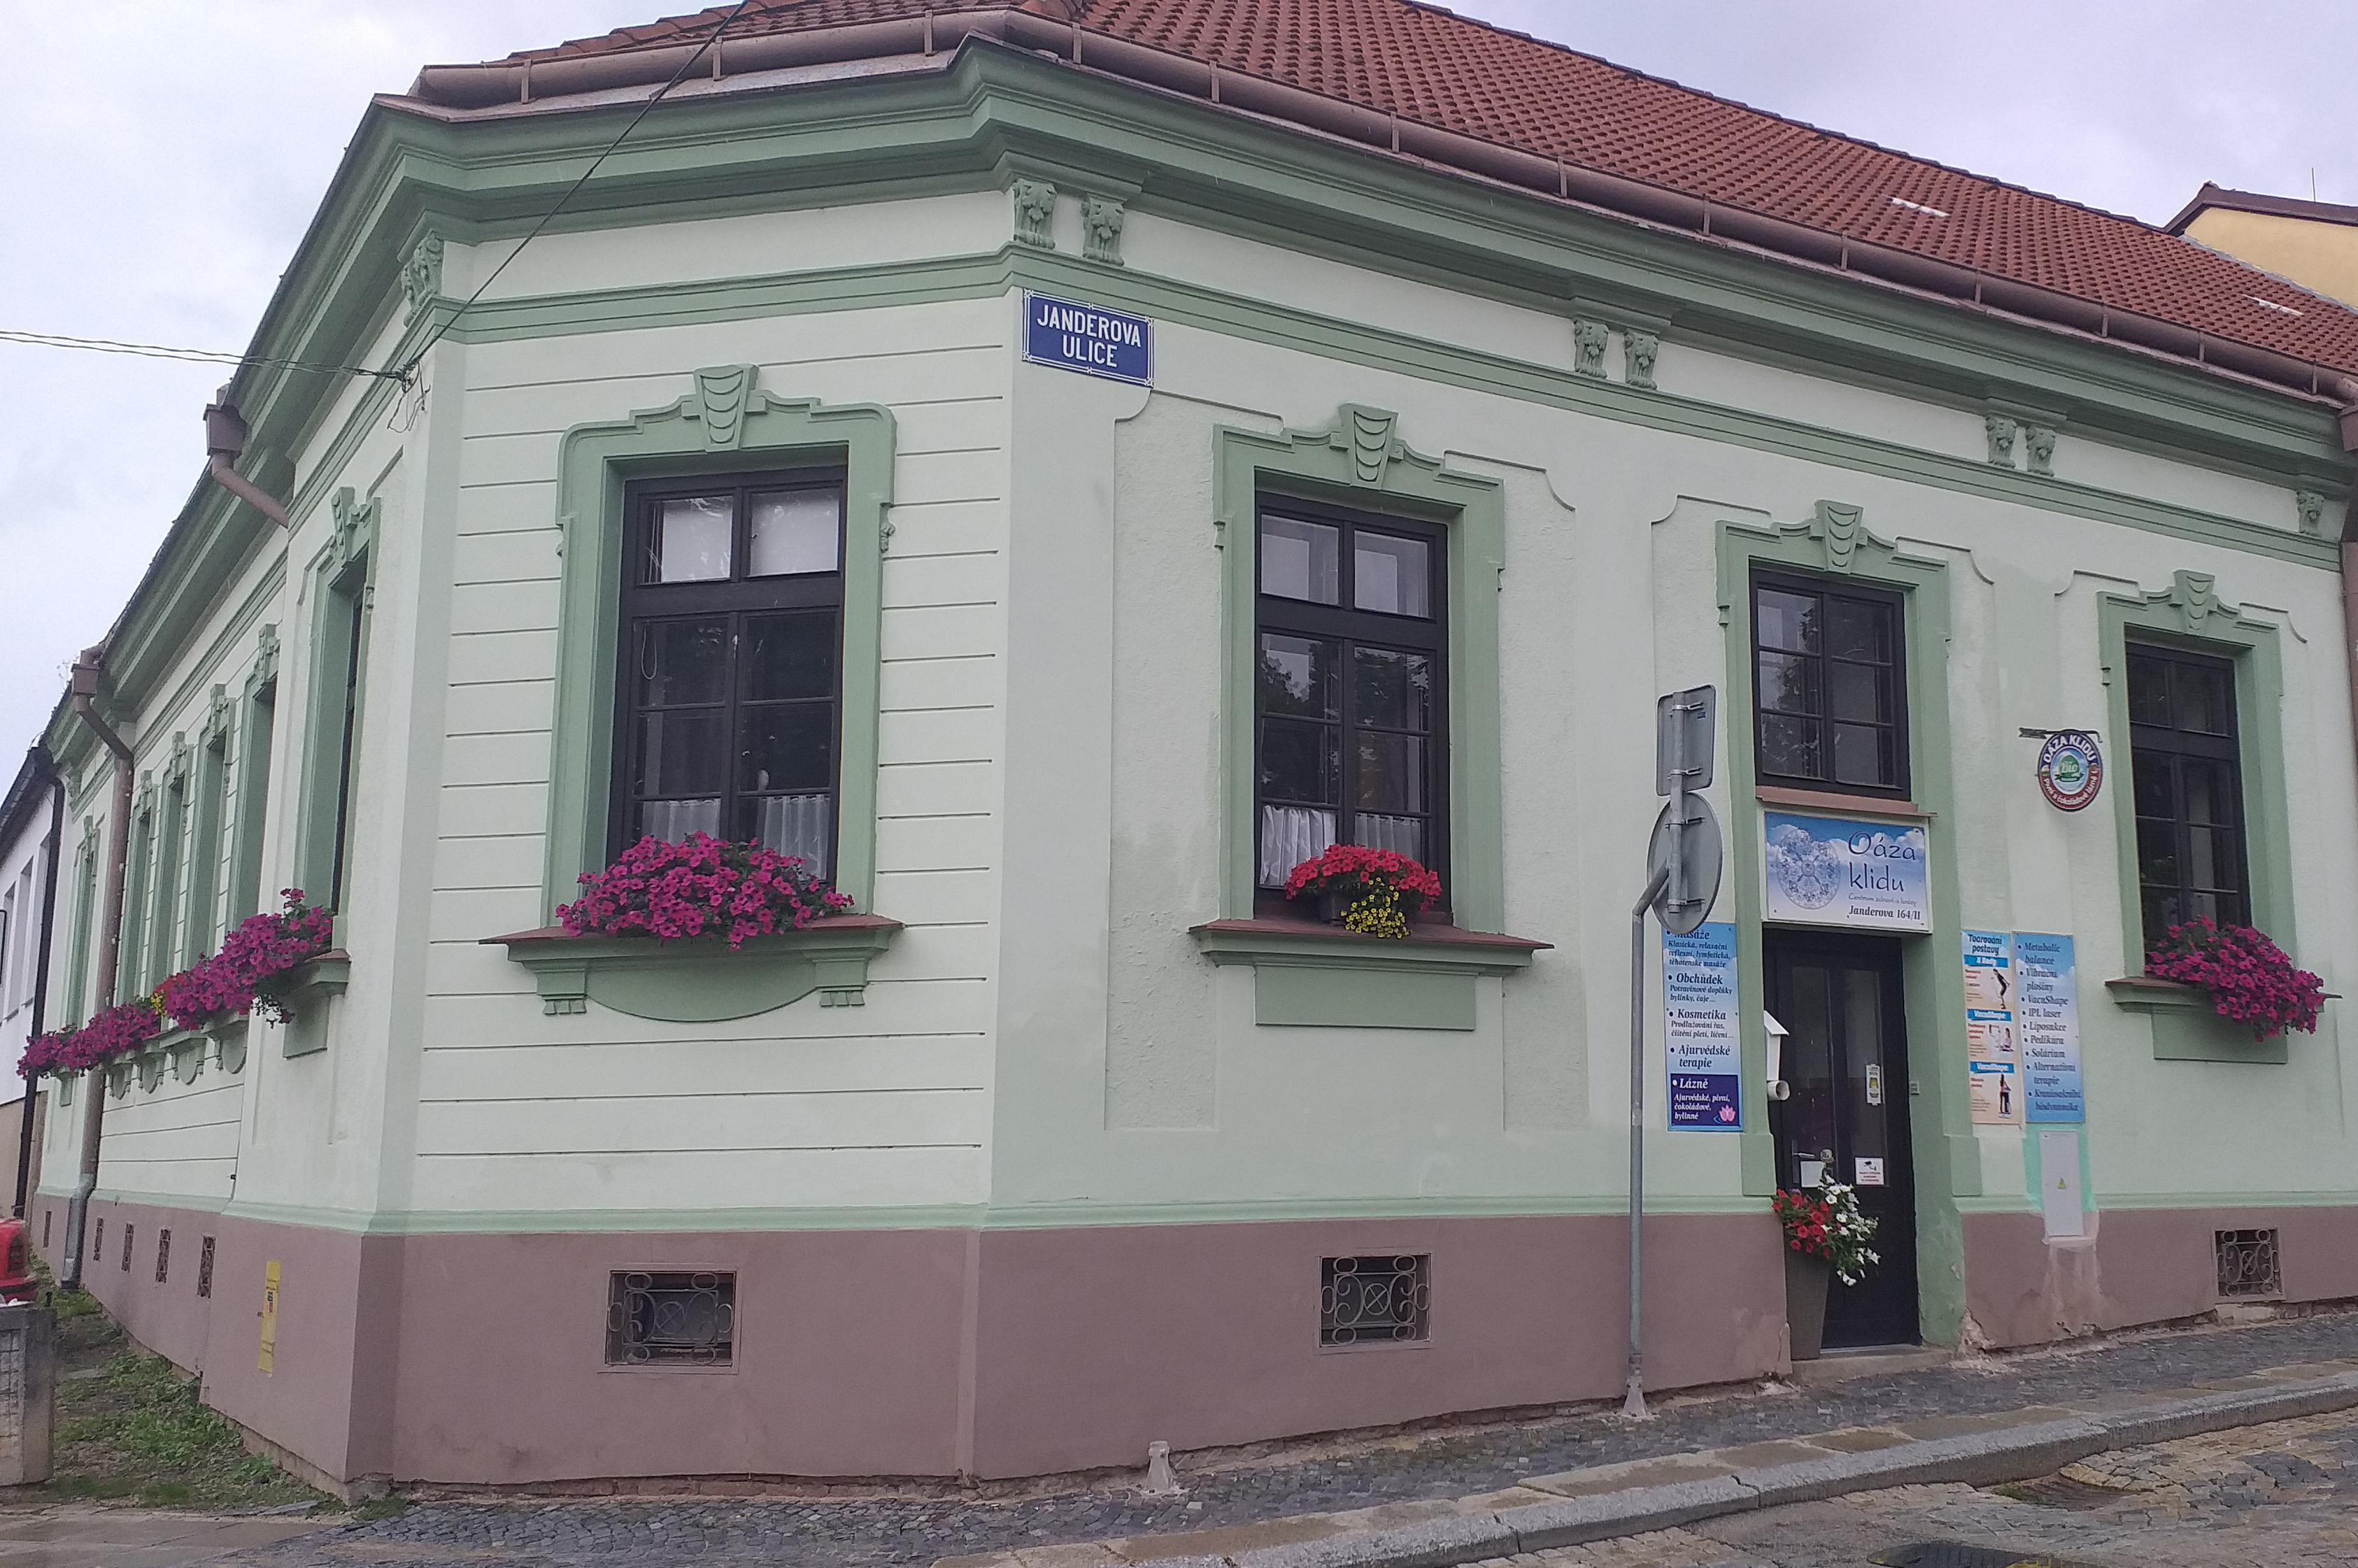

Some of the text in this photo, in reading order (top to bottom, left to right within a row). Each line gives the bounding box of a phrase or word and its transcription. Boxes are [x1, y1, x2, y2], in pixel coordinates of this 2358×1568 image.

[1037, 305, 1141, 348] JANDEROVA
[1063, 334, 1117, 367] ULICE
[2043, 734, 2096, 762] OÁZA KLIDU
[1848, 831, 1916, 860] Oáza
[1849, 862, 1904, 892] klidu
[1848, 892, 1875, 901] Centrum
[1849, 905, 1921, 920] Janderova 164/II
[2024, 942, 2061, 953] Metabolic
[2024, 955, 2055, 965] balance
[1676, 973, 1723, 985] Obchůdek
[1670, 993, 1695, 1002] bylinky,
[2028, 995, 2068, 1007] VacuShape
[1677, 1008, 1726, 1020] Kosmetika
[2043, 1008, 2061, 1018] laser
[2029, 1021, 2067, 1032] Liposukce
[1678, 1044, 1731, 1057] Ajurvédské
[1679, 1057, 1712, 1070] terapie
[1679, 1077, 1708, 1089] Lázně
